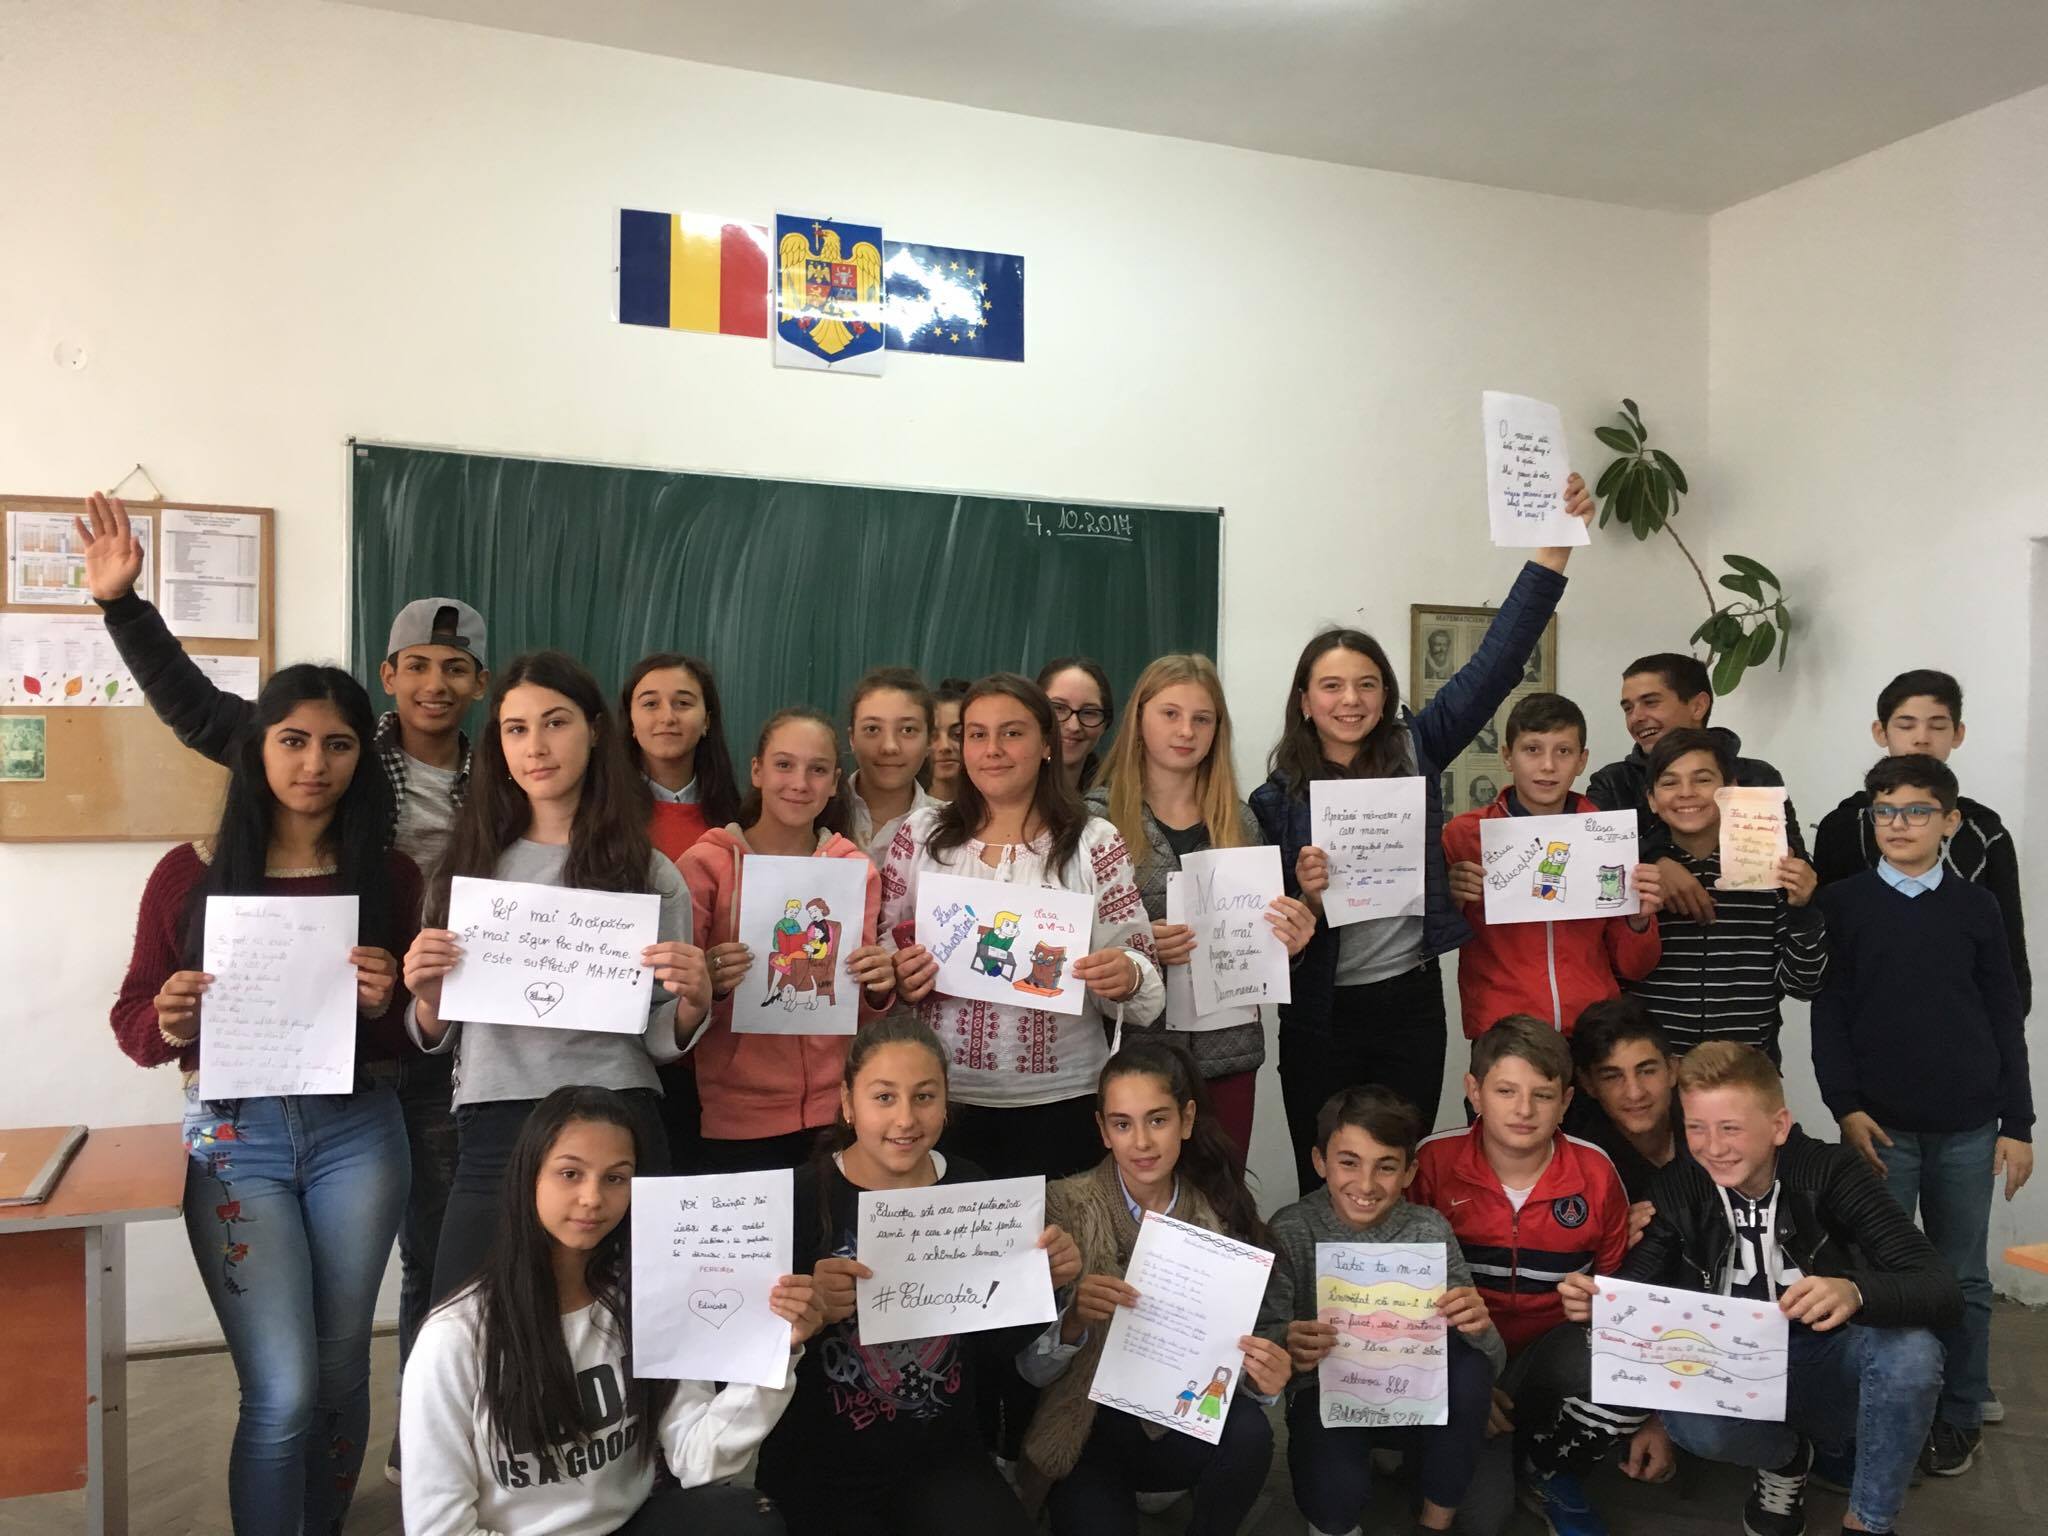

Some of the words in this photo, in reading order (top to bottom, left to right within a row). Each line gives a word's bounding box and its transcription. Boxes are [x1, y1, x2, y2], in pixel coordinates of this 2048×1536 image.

[1058, 506, 1133, 536] 10.2017
[1196, 867, 1266, 917] Mama
[530, 909, 560, 924] mai
[568, 912, 636, 934] încăpător
[482, 929, 510, 942] mai
[518, 931, 551, 950] sigur
[556, 934, 573, 951] loc
[575, 942, 595, 954] din
[482, 951, 513, 965] este
[523, 955, 579, 974] sufletul
[957, 1202, 977, 1213] mai
[923, 1245, 968, 1261] schimba
[1331, 1251, 1366, 1272] Tată
[497, 1460, 530, 1489] IS
[538, 1453, 561, 1486] A
